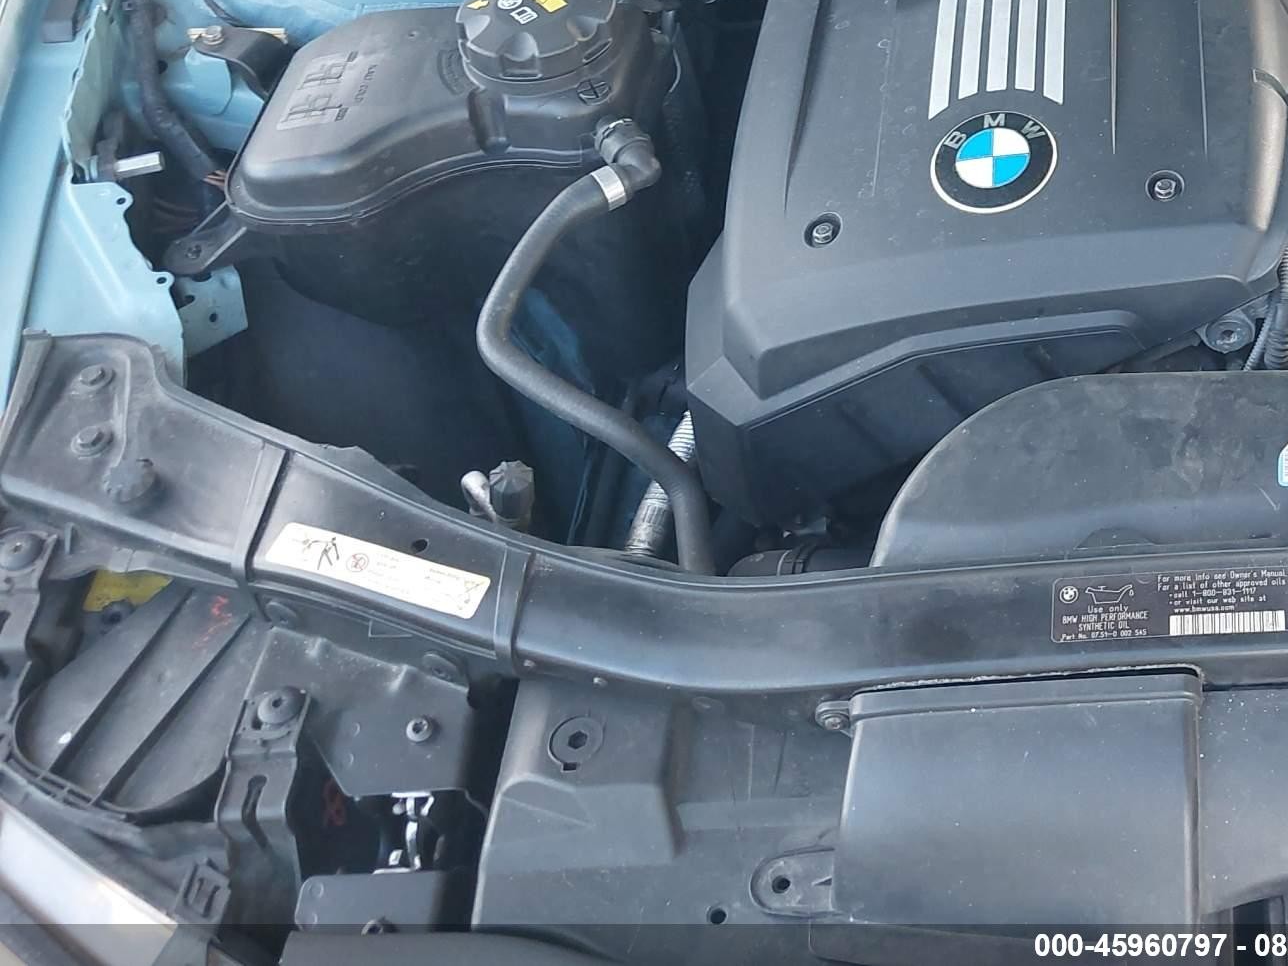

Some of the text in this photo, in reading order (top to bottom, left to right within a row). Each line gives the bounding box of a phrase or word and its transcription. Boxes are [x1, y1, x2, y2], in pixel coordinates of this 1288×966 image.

[943, 113, 1046, 150] BMW
[1157, 574, 1170, 583] For
[1174, 574, 1191, 582] more
[1195, 572, 1210, 581] info
[1213, 572, 1227, 580] see
[1229, 570, 1258, 579] Owner's
[1182, 581, 1196, 590] list
[1200, 581, 1209, 589] of
[1212, 580, 1231, 588] other
[1235, 578, 1268, 588] approved
[1271, 577, 1286, 586] oils
[1185, 597, 1203, 606] visit
[1240, 595, 1255, 603] site
[1258, 594, 1267, 602] at
[1087, 603, 1129, 614] Use only
[1173, 604, 1235, 614] www.bmwusa.com
[1062, 610, 1149, 625] BMW HIGH PERFORMANCE
[1078, 620, 1130, 632] SYNTHETIC OIL
